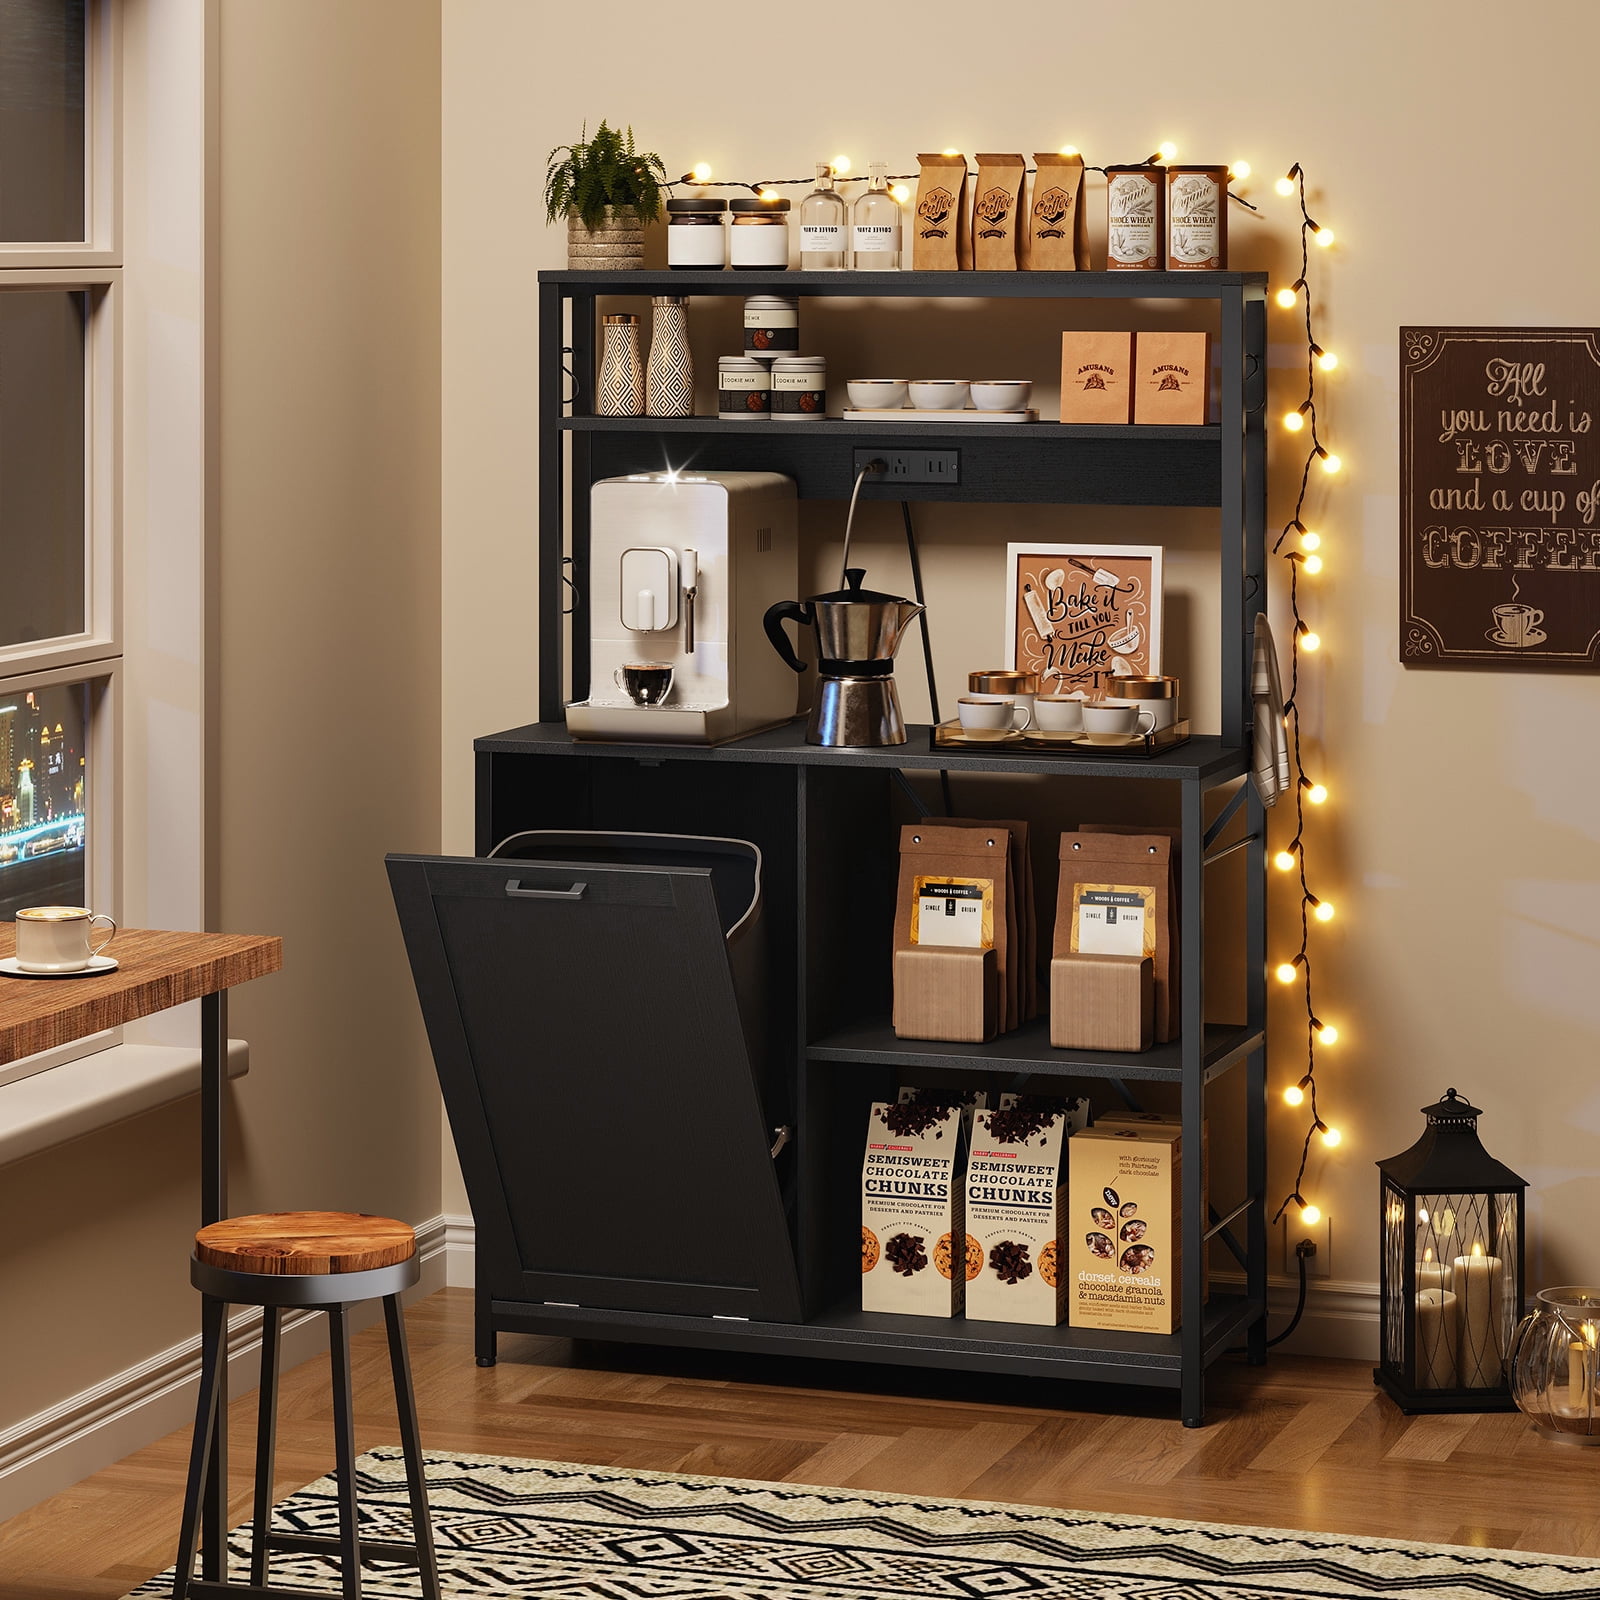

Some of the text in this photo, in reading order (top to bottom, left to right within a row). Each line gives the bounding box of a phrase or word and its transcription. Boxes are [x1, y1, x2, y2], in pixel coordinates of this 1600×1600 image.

[918, 195, 956, 217] Coffee
[976, 195, 1014, 217] Coffee
[1034, 195, 1073, 217] Coffee
[1110, 216, 1154, 224] WHOLE WHEAT
[1172, 216, 1217, 224] WHOLE WHEAT
[1078, 364, 1114, 376] AMUSANS
[1152, 364, 1190, 376] AMUSANS
[1485, 357, 1547, 407] All
[1438, 400, 1592, 443] you need is
[1455, 438, 1578, 476] LOVE
[1429, 477, 1600, 525] and a cup of
[1419, 525, 1600, 573] COFFEE
[1046, 582, 1098, 623] Bake
[1068, 612, 1112, 635] TILL YOU
[1042, 630, 1111, 670] Make
[867, 1154, 950, 1168] SEMISWEET
[971, 1161, 1055, 1175] SEMISWEET
[1133, 1156, 1160, 1164] gloriously
[866, 1166, 949, 1181] CHOCOLATE
[970, 1173, 1054, 1188] CHOCOLATE
[865, 1179, 948, 1197] CHUNKS
[969, 1186, 1053, 1204] CHUNKS
[1105, 1190, 1117, 1205] new
[1078, 1270, 1161, 1286] dorset cereals
[1078, 1282, 1163, 1296] chocolate granola
[1078, 1290, 1166, 1306] & macadamia nuts
